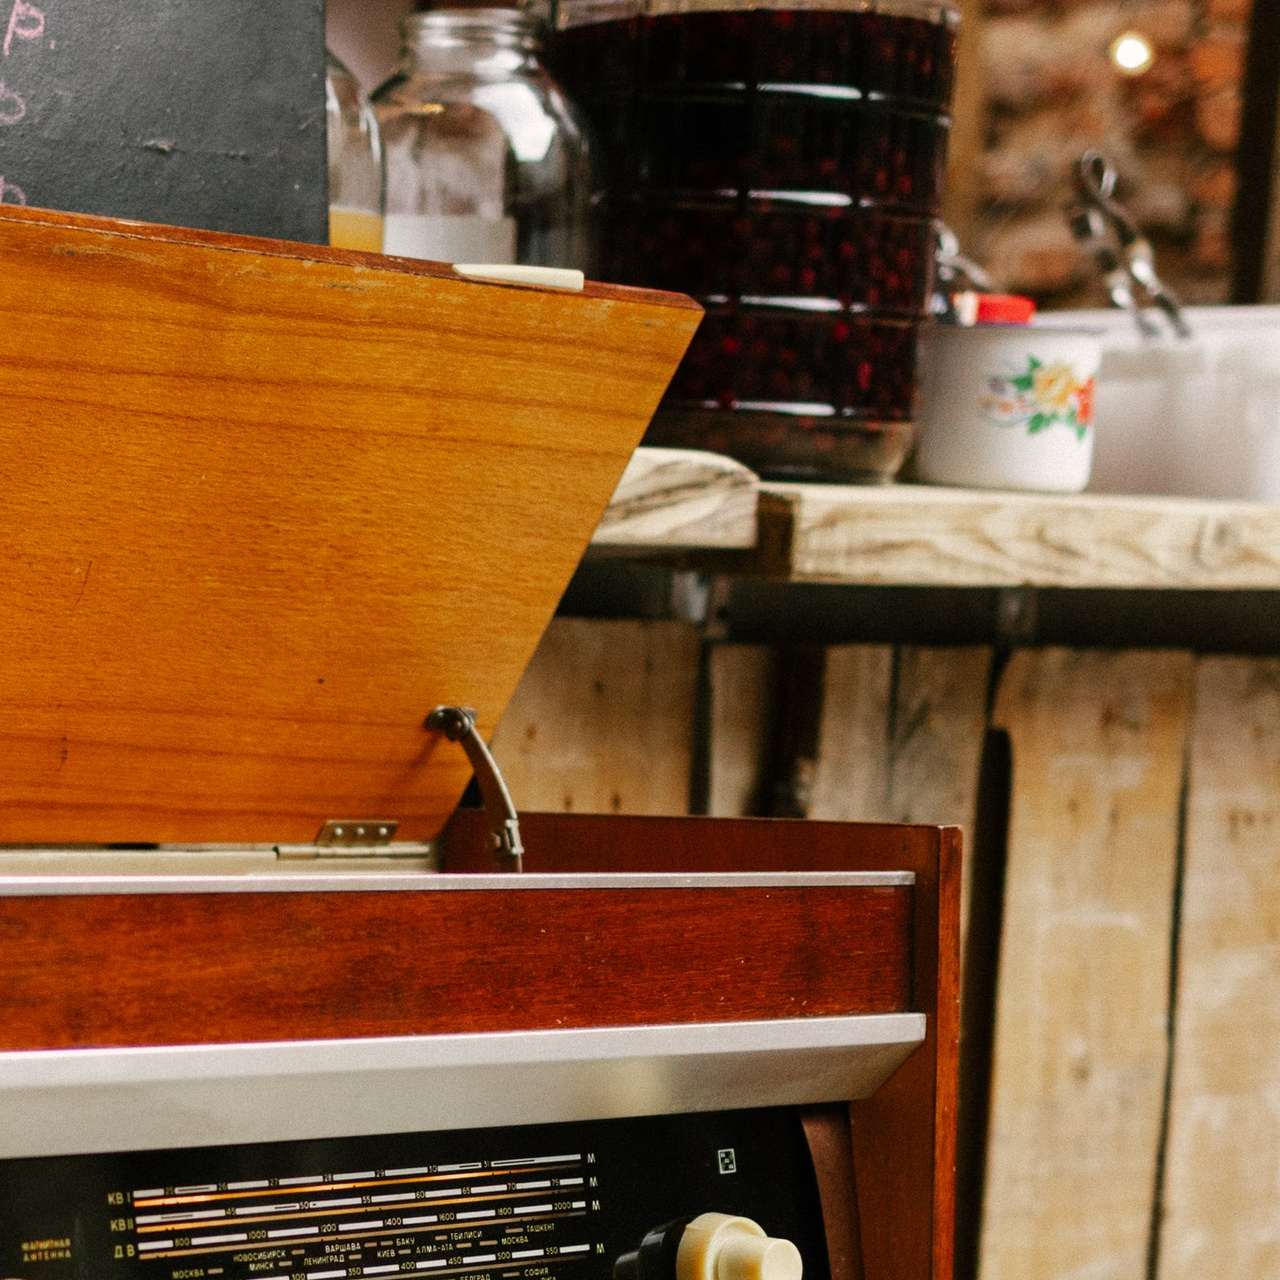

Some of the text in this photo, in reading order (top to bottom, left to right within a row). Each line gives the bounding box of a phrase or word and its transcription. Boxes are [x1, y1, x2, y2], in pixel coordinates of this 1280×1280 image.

[108, 1192, 123, 1205] КВ
[219, 1182, 227, 1191] 26
[270, 1177, 279, 1186] 27
[324, 1173, 333, 1182] 28
[375, 1169, 385, 1178] 29
[428, 1165, 438, 1173] 30
[110, 1219, 126, 1232] КВ
[226, 1207, 236, 1216] 45
[299, 1201, 310, 1210] 50
[362, 1195, 372, 1204] 55
[416, 1190, 425, 1199] 60
[462, 1186, 471, 1195] 65
[507, 1182, 516, 1191] 70
[551, 1178, 560, 1187] 75
[249, 1230, 267, 1240] 1000
[321, 1223, 337, 1233] 1200
[385, 1217, 401, 1226] 1400
[439, 1212, 455, 1222] 1600
[498, 1207, 513, 1216] 1800
[554, 1201, 571, 1211] 2000
[172, 1236, 529, 1280] МОСКВА МИНСК ЛЕНИНГРАД КИЕВ АЛМА-АТА МОСКВА
[233, 1223, 555, 1263] НОВОСИБИРСК ВАРШАВА БАКУ ТБИЛИСИ ТАШКЕНТ
[348, 1268, 362, 1276] 350
[401, 1261, 416, 1270] 400
[448, 1256, 462, 1265] 450
[497, 1251, 511, 1260] 500
[545, 1246, 559, 1255] 550
[524, 1267, 549, 1277] СОФИЯ
